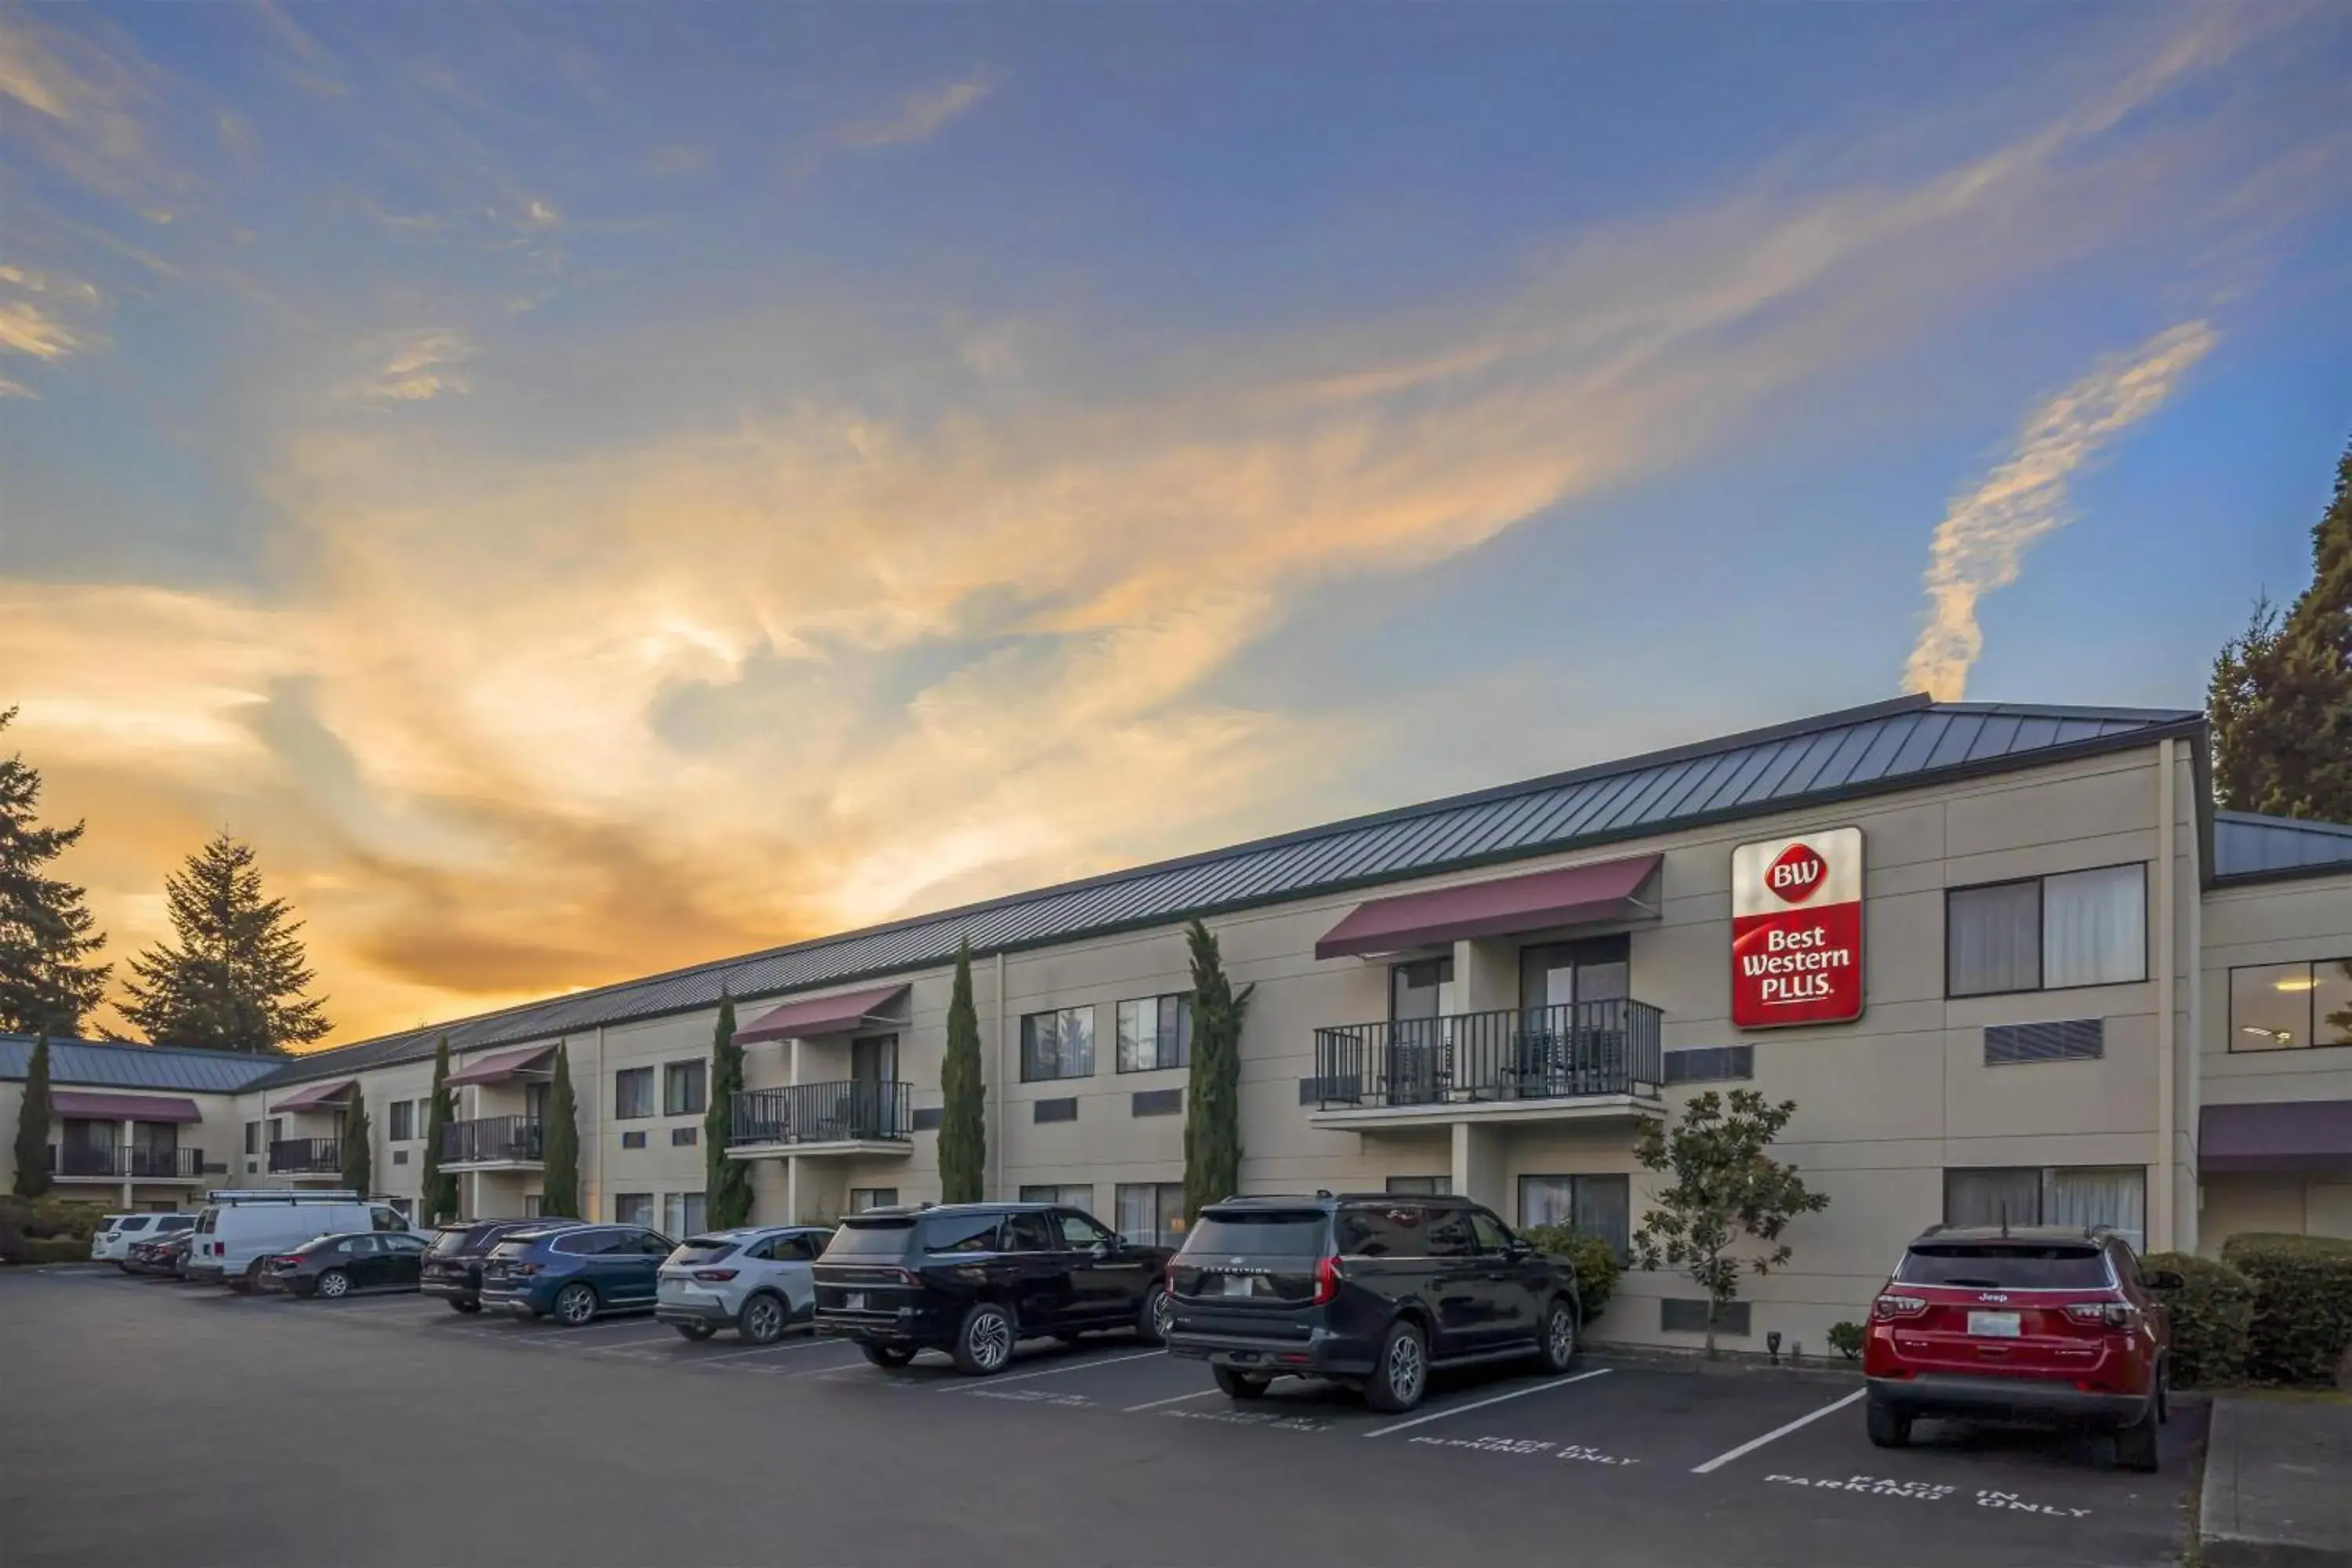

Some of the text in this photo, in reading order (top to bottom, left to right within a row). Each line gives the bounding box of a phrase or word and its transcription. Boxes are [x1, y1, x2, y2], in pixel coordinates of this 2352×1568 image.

[1774, 860, 1819, 887] BW
[1768, 927, 1825, 952] Best
[1743, 949, 1849, 976] Western
[1979, 1292, 2008, 1303] Jeep
[1408, 1436, 1641, 1465] PARKING ONLY
[1764, 1475, 2092, 1517] PARKING ONLY
[1849, 1475, 2019, 1501] FACE IN
